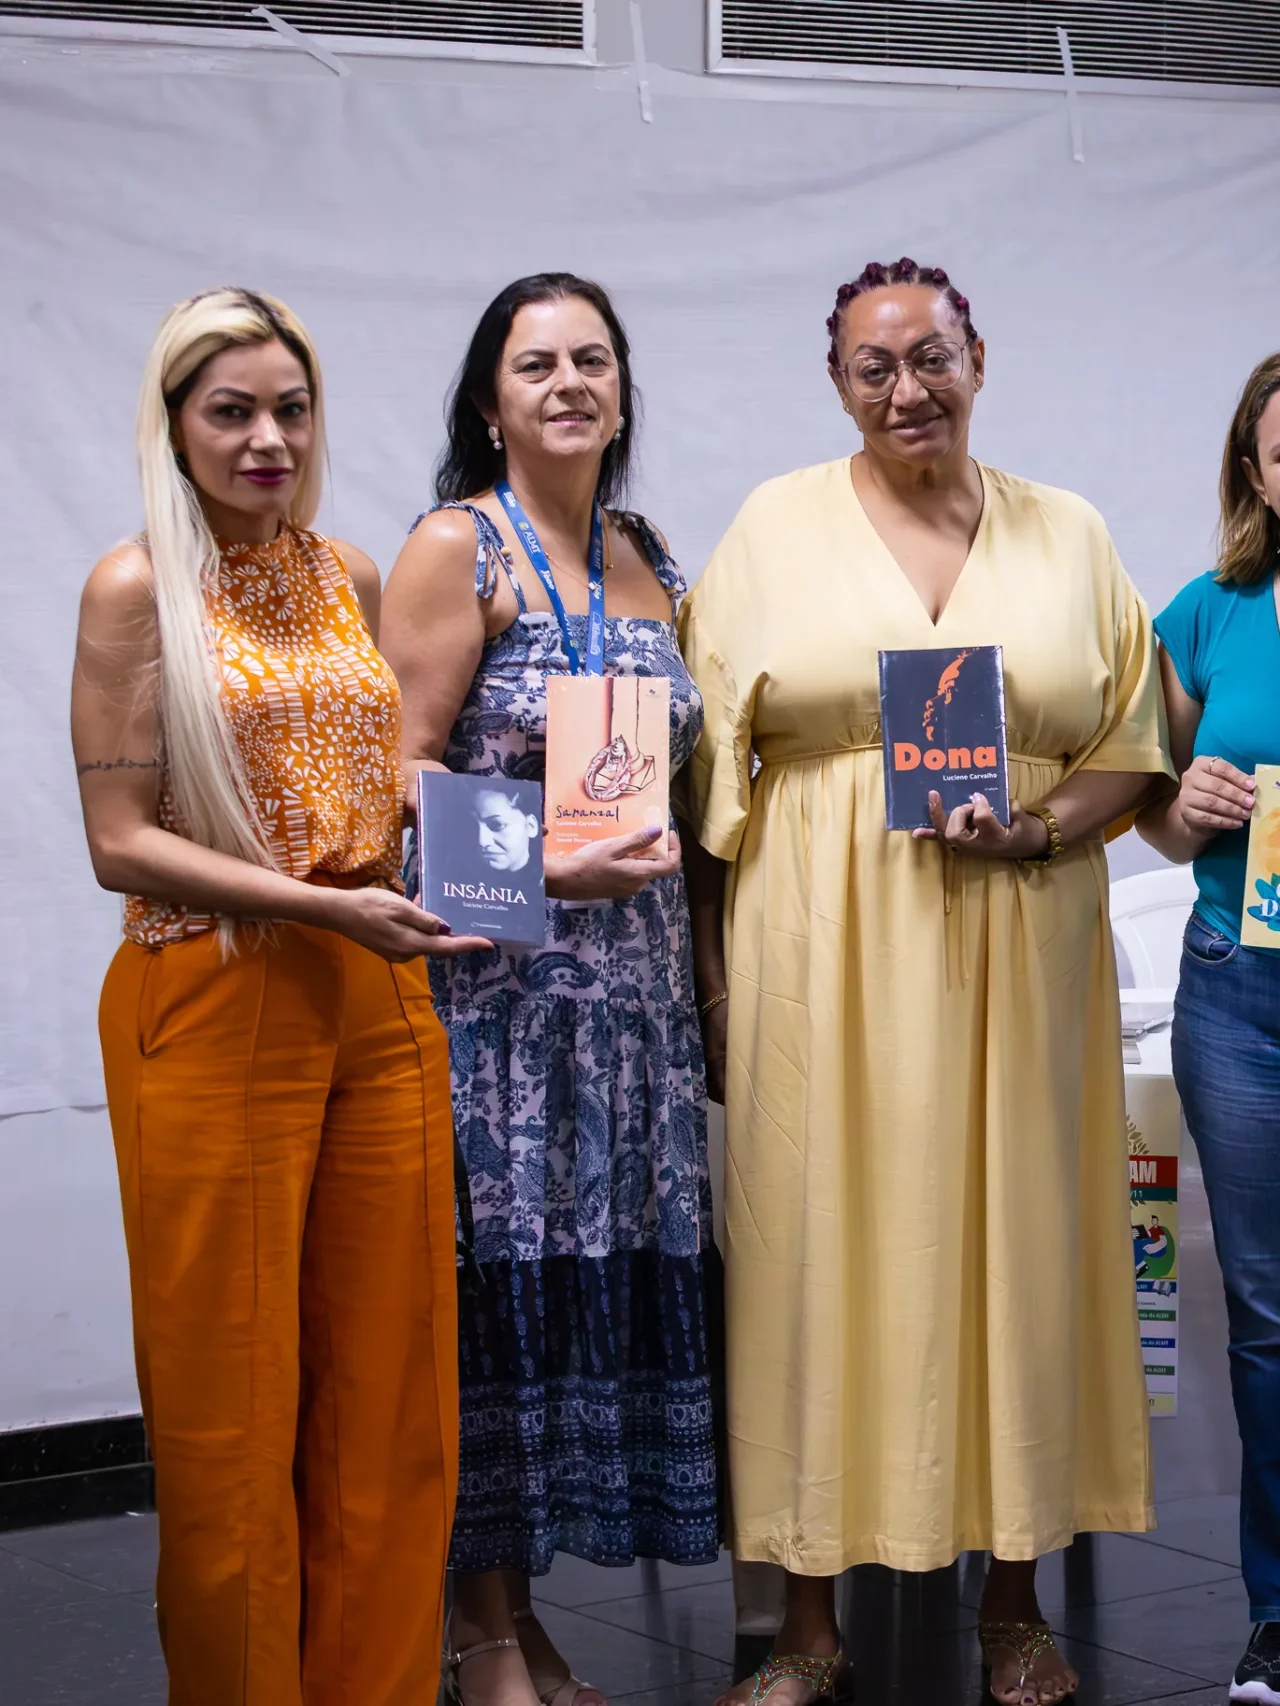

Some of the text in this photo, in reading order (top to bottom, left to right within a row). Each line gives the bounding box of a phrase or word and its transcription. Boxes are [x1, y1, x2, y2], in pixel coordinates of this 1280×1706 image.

[524, 531, 541, 554] ALMT
[893, 742, 997, 771] Dona
[969, 772, 998, 780] Carvalho
[443, 881, 528, 905] INSÂNIA
[1130, 1161, 1157, 1184] AM
